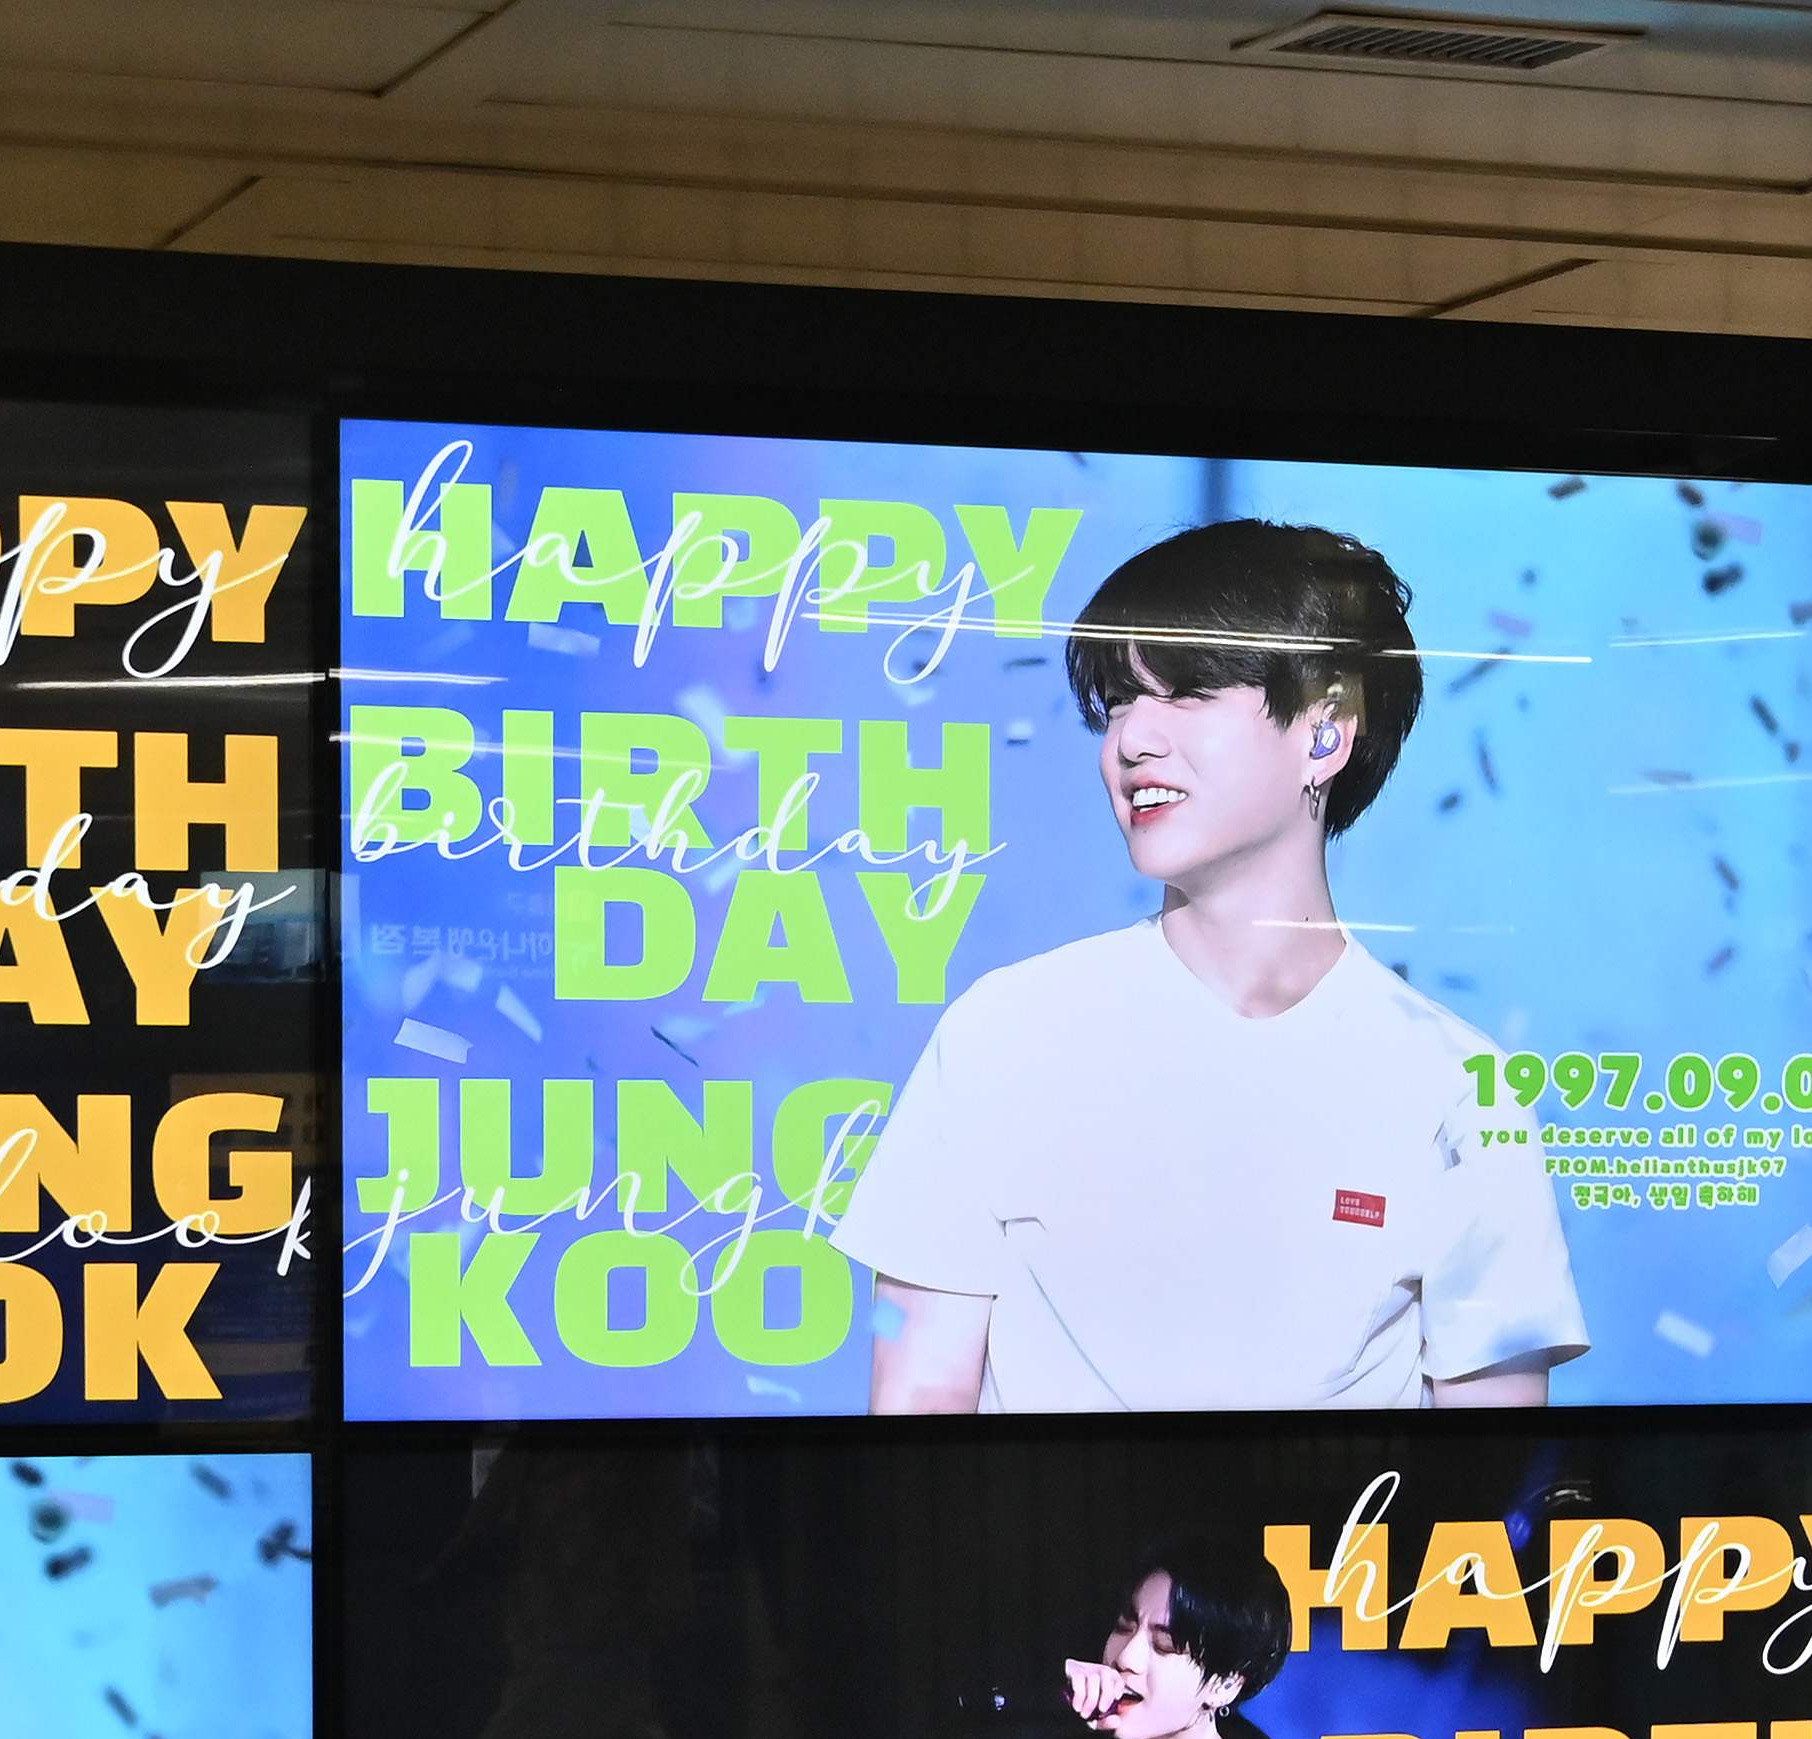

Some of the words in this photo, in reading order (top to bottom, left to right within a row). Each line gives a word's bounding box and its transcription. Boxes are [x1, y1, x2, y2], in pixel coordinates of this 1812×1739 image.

[350, 478, 1083, 639] HAPPY
[387, 440, 1035, 685] happy
[349, 704, 991, 852] BIRTH
[350, 761, 1008, 921] birthday
[554, 866, 987, 1003] DAY
[343, 1099, 883, 1299] jungk
[356, 1078, 894, 1216] JUNG
[1479, 1125, 1529, 1148] you
[1540, 1123, 1651, 1147] deserve
[1660, 1123, 1697, 1147] all
[1705, 1124, 1736, 1148] of
[1744, 1129, 1784, 1150] my
[1647, 1184, 1691, 1209] 생일
[409, 1229, 856, 1367] KOO
